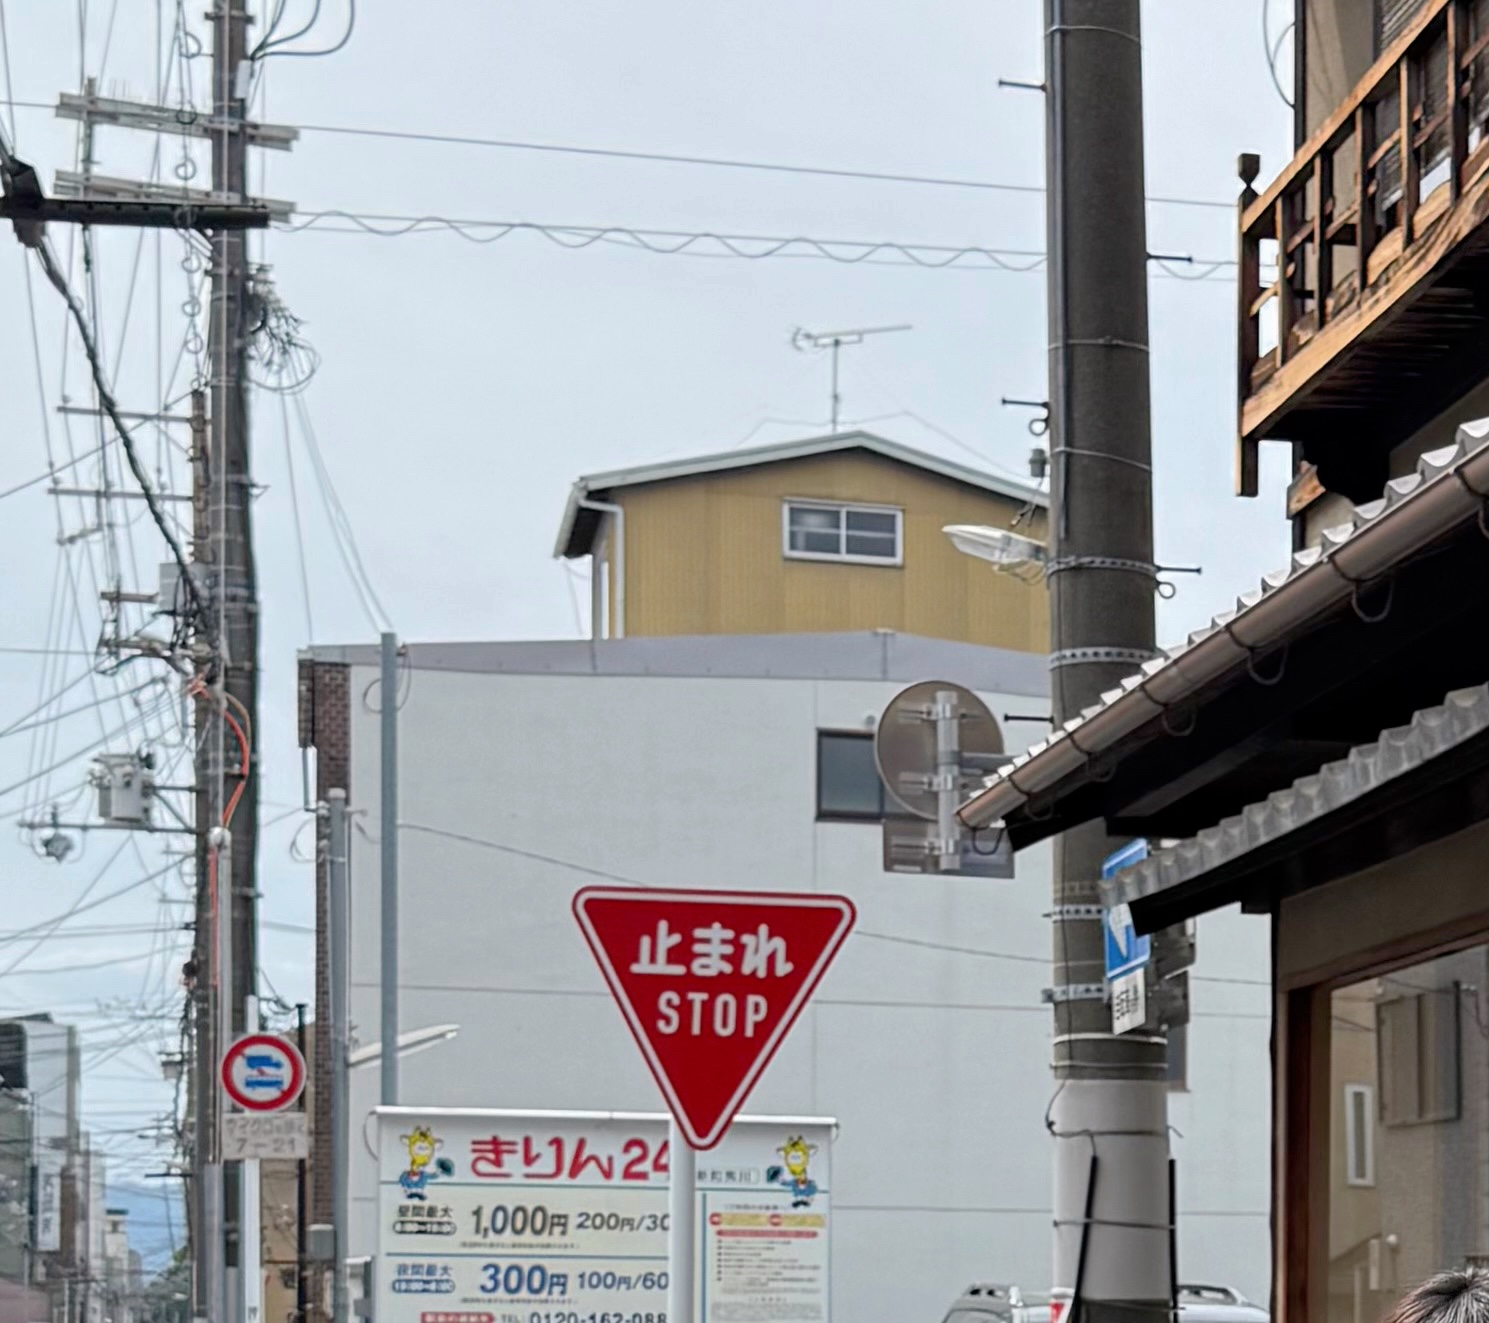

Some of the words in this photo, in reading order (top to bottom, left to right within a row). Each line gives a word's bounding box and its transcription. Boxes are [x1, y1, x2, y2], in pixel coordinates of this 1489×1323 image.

[629, 918, 795, 979] 止まれ
[656, 990, 769, 1038] STOP
[471, 1205, 569, 1239] 1,000円
[480, 1263, 569, 1296] 300円
